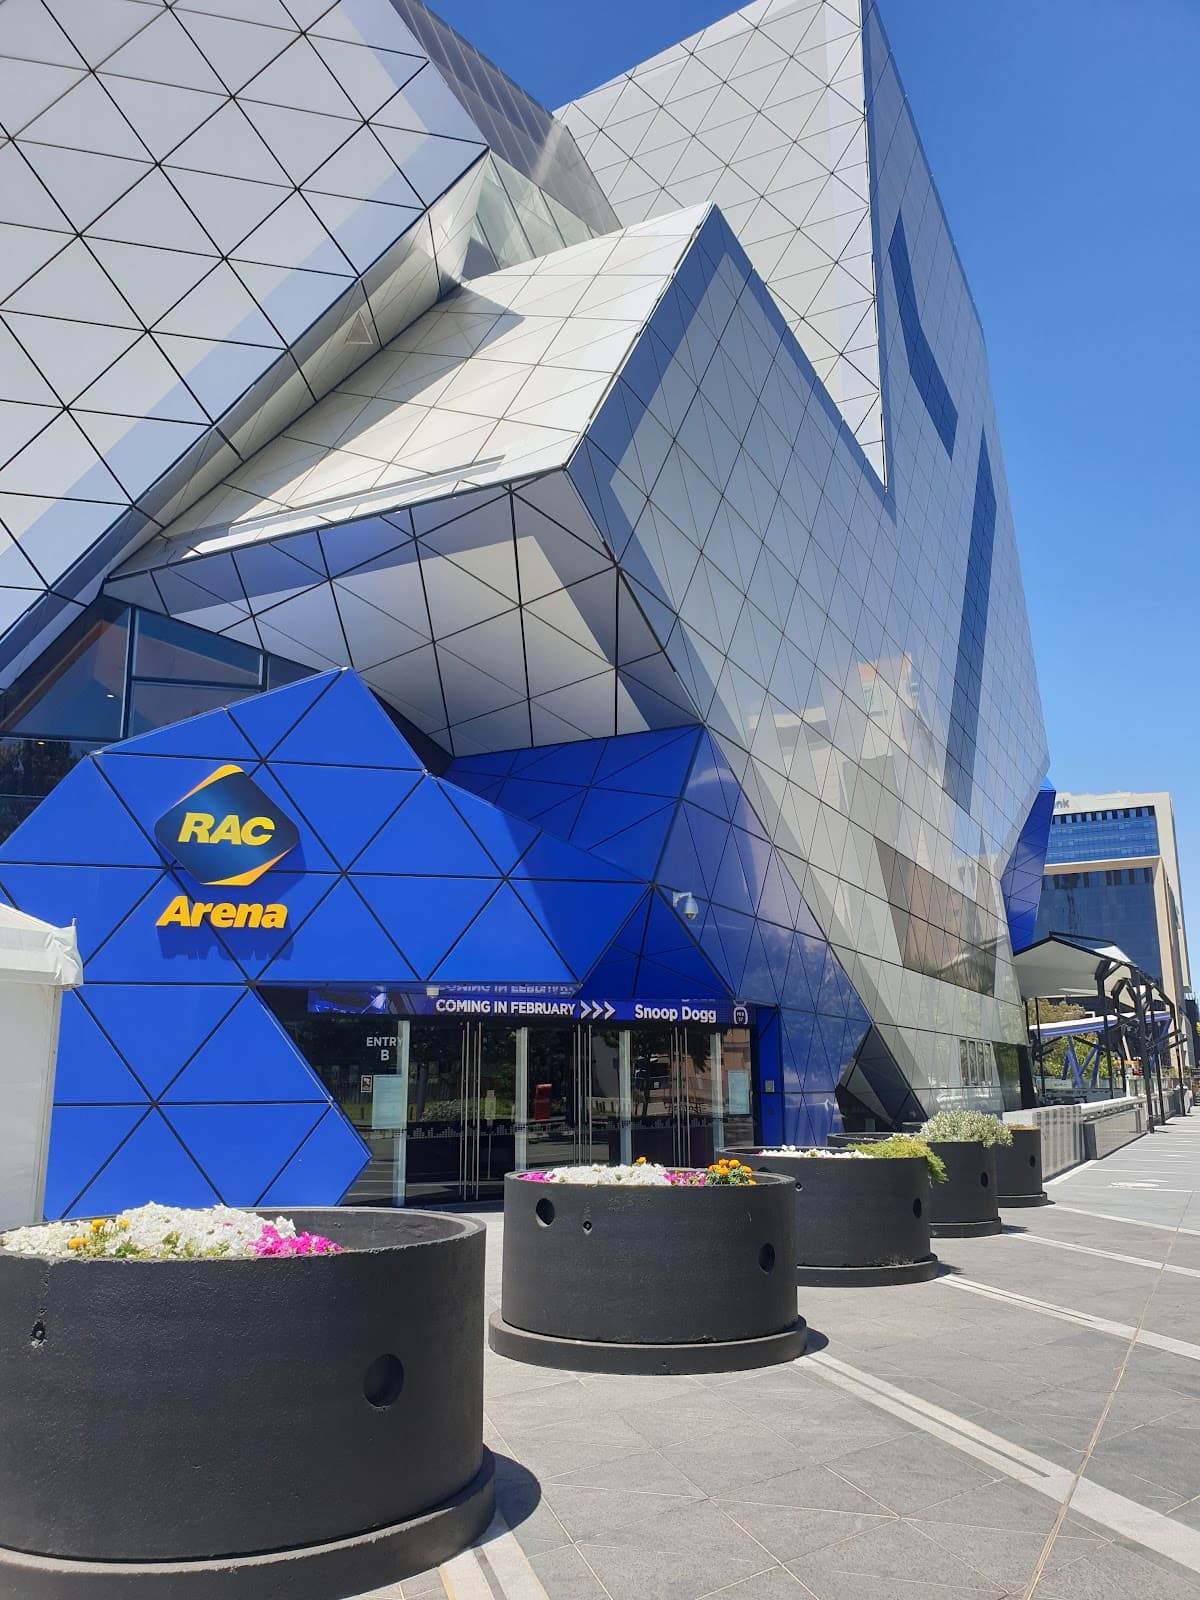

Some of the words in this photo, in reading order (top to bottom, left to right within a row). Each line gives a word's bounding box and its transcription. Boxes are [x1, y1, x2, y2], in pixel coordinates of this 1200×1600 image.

[177, 812, 275, 846] RAC
[155, 895, 288, 929] Arena
[435, 999, 491, 1014] COMING
[494, 1000, 508, 1014] IN
[510, 1001, 576, 1015] FEBRUARY
[634, 1003, 679, 1021] Snoop
[681, 1006, 717, 1023] Dogg
[366, 1036, 403, 1047] ENTRY
[380, 1049, 390, 1061] B
